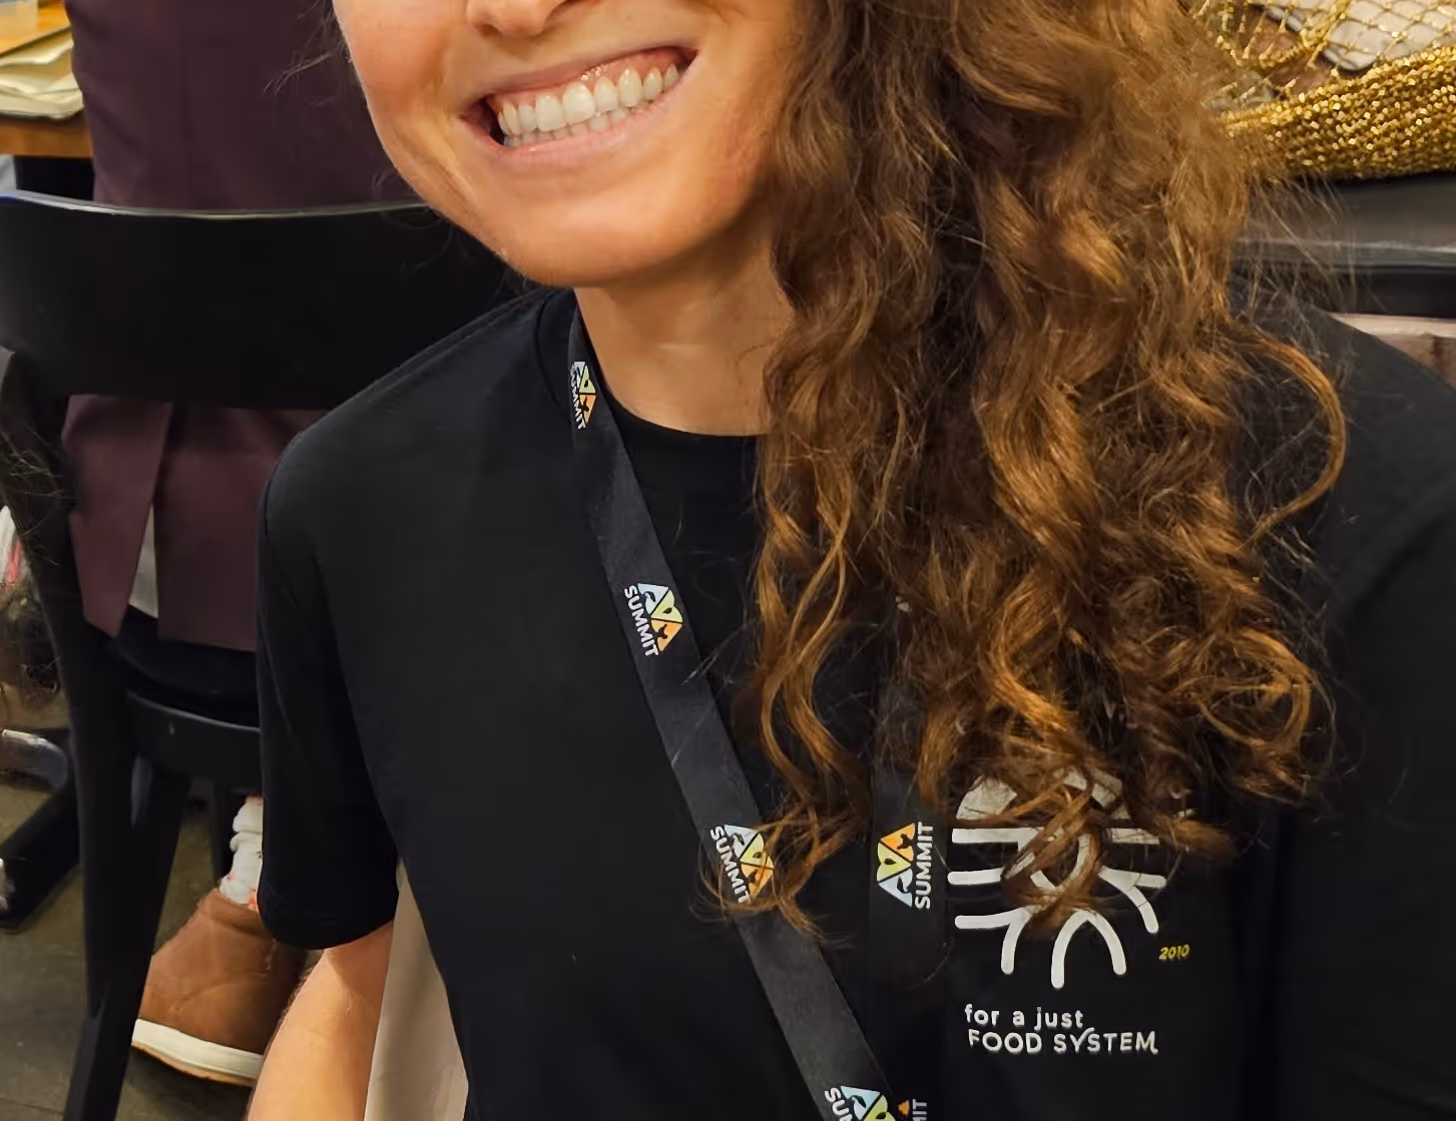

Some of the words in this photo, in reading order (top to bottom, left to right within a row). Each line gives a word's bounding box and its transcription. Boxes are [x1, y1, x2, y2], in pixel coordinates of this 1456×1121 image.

[623, 584, 659, 657] SUMMIT
[709, 825, 750, 904] SUMMIT
[914, 821, 934, 910] SUMMIT
[1158, 944, 1191, 960] 2010
[964, 1003, 1000, 1026] for
[1012, 1010, 1025, 1027] a
[1033, 1006, 1084, 1031] just
[968, 1029, 1043, 1054] FOOD
[1053, 1027, 1159, 1055] SYSTEM
